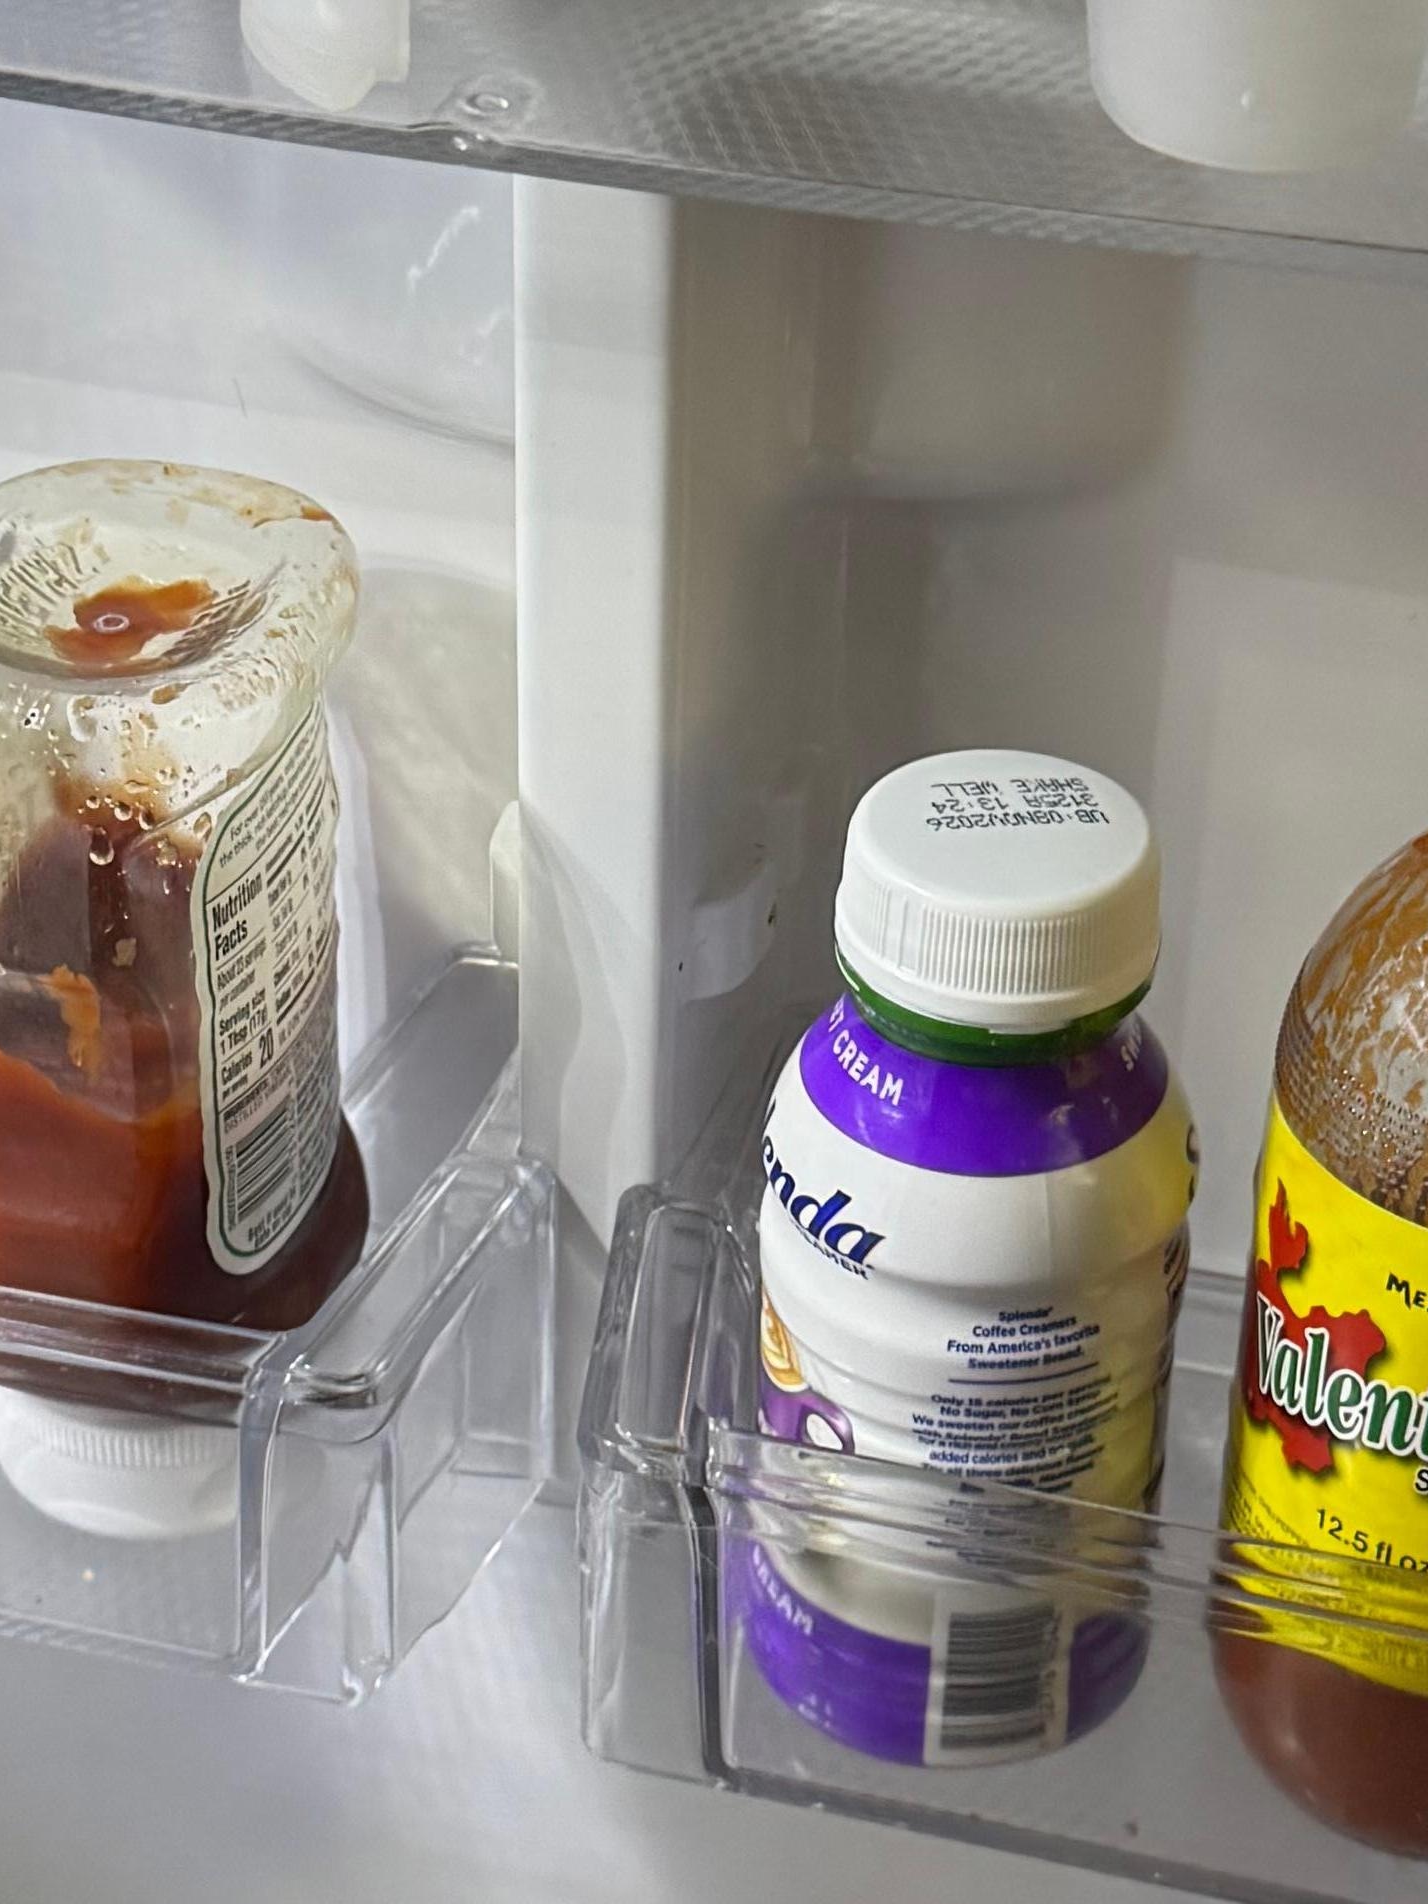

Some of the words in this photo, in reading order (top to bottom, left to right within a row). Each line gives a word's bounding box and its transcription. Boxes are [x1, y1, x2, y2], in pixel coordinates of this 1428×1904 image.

[212, 871, 263, 933] Nutrition
[214, 919, 249, 962] Facts
[258, 1026, 274, 1070] 20
[832, 1029, 905, 1107] CREAM
[947, 1339, 985, 1354] From
[987, 1337, 1052, 1355] America's
[1054, 1324, 1101, 1347] favorite
[972, 1324, 1017, 1338] Coffee
[1018, 1315, 1078, 1337] Creamers
[968, 1356, 1041, 1370] Sweetener
[912, 1413, 935, 1428] We
[928, 1448, 970, 1464] added
[971, 1449, 1019, 1465] calories
[1020, 1448, 1047, 1463] and
[1316, 1507, 1369, 1554] 12.5
[1374, 1540, 1393, 1567] fl
